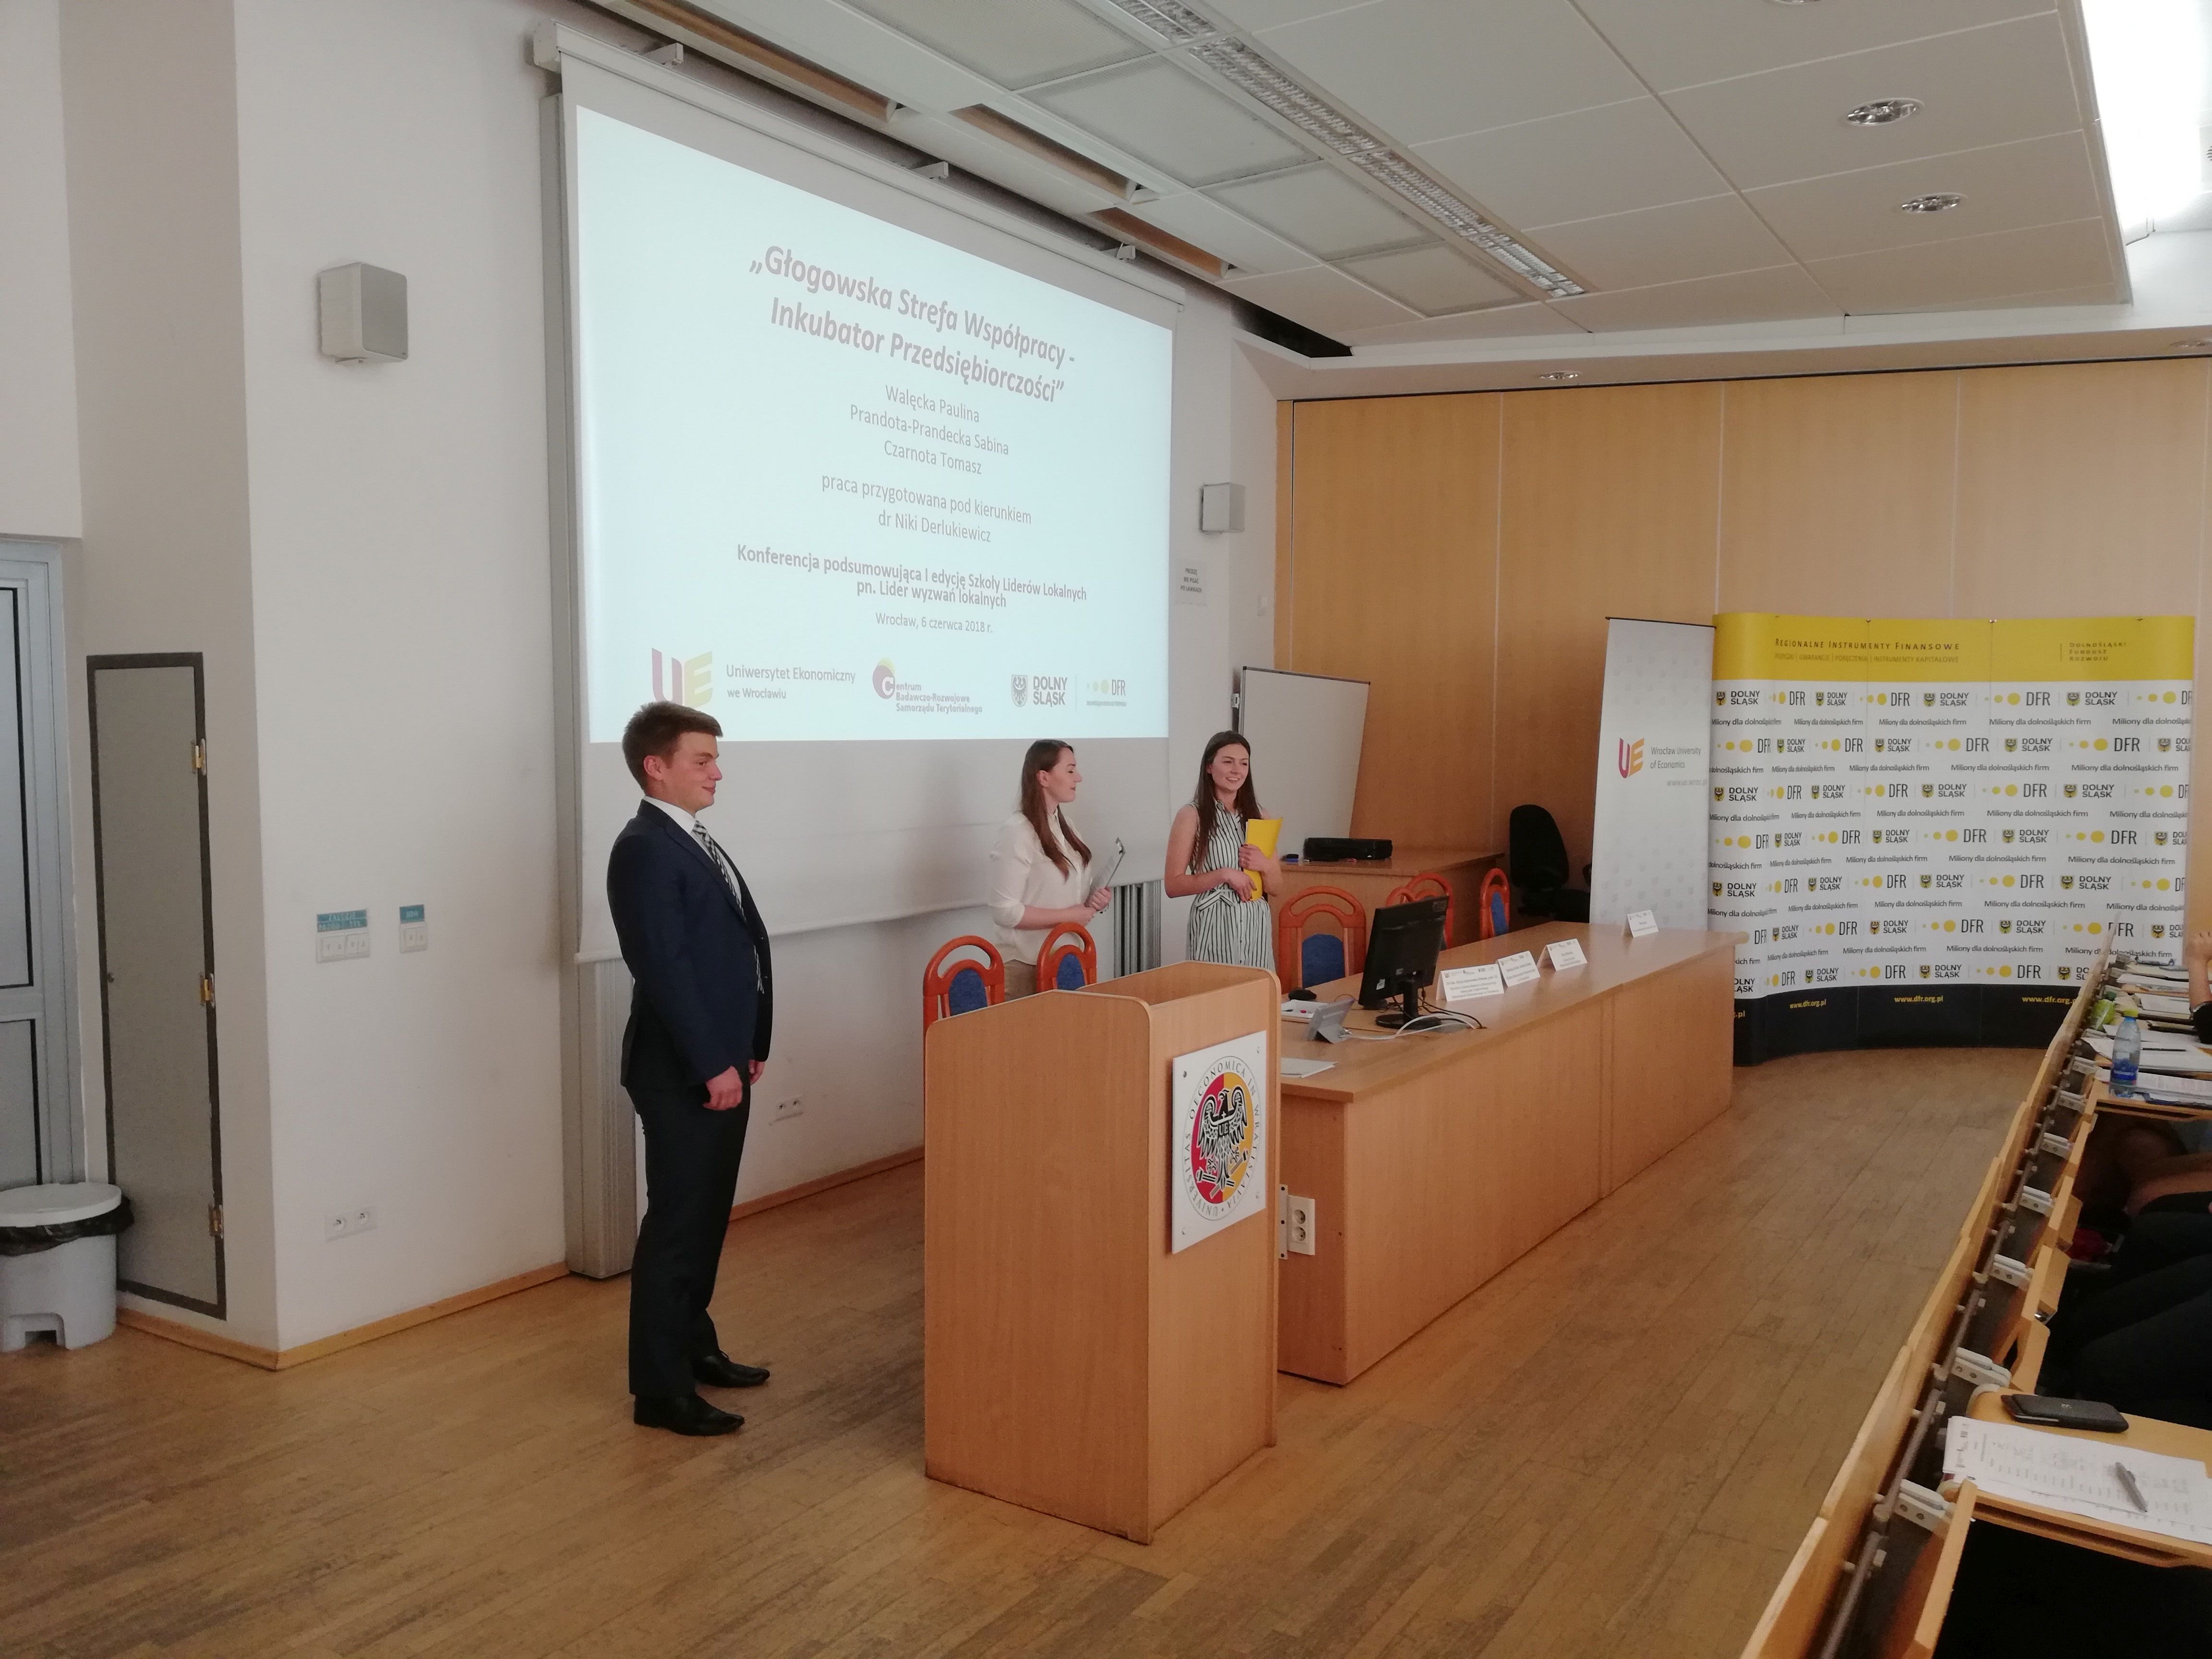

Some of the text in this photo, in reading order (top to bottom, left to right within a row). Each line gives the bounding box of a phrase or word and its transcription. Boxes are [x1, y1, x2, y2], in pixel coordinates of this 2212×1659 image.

[749, 246, 892, 310] „Głogowska
[898, 289, 958, 332] Strefa
[964, 310, 1066, 370] Współpracy
[771, 297, 1064, 403] Inkubator Przedsiębiorczości”
[885, 385, 980, 422] Walęcka Paulina
[850, 404, 1009, 456] Prandota-Prandecka Sabina
[884, 440, 982, 475] Czarnota Tomasz
[821, 475, 1032, 525] praca przygotowana pod kierunkiem
[878, 510, 991, 543] dr Niki Derlukiewicz
[737, 544, 1087, 601] Konferencja podsumowująca I edycję Szkoły Liderów Lokalnych
[856, 580, 1006, 609] pn. Lider wyzwań lokalnych
[875, 612, 993, 633] Wrocław, 6 czerwca 2018 r.
[652, 648, 712, 708] UE
[726, 664, 855, 684] Uniwersytet Ekonomiczny
[1033, 676, 1068, 691] DOLNY
[1112, 679, 1126, 696] DFR
[727, 689, 740, 697] we
[896, 692, 970, 704] Badawczo-Rozwojowe
[1033, 689, 1066, 708] ŚLĄSK
[1790, 691, 1805, 705] DFR
[1891, 692, 1910, 706] DFR
[2026, 692, 2050, 706] DFR
[896, 704, 983, 714] Samorządu Terytorialnego
[1677, 747, 1701, 755] University
[1845, 738, 1863, 752] DFR
[1966, 738, 1989, 752] DFR
[2114, 737, 2140, 752] DFR
[1619, 737, 1645, 778] UE
[1650, 760, 1656, 769] of
[1787, 785, 1802, 800] DFR
[1889, 783, 1908, 797] DFR
[2023, 783, 2047, 797] DFR
[1842, 830, 1860, 844] DFR
[1963, 829, 1986, 842] DFR
[2111, 830, 2137, 844] DFR
[1887, 874, 1906, 888] DFR
[2020, 875, 2044, 888] DFR
[1839, 921, 1857, 935] DFR
[1961, 919, 1984, 933] DFR
[1885, 965, 1906, 979] DFR
[2017, 965, 2041, 979] DFR
[1789, 999, 1827, 1009] www.dfr.org.pl
[1247, 1078, 1256, 1096] IN
[1218, 1123, 1229, 1136] UE
